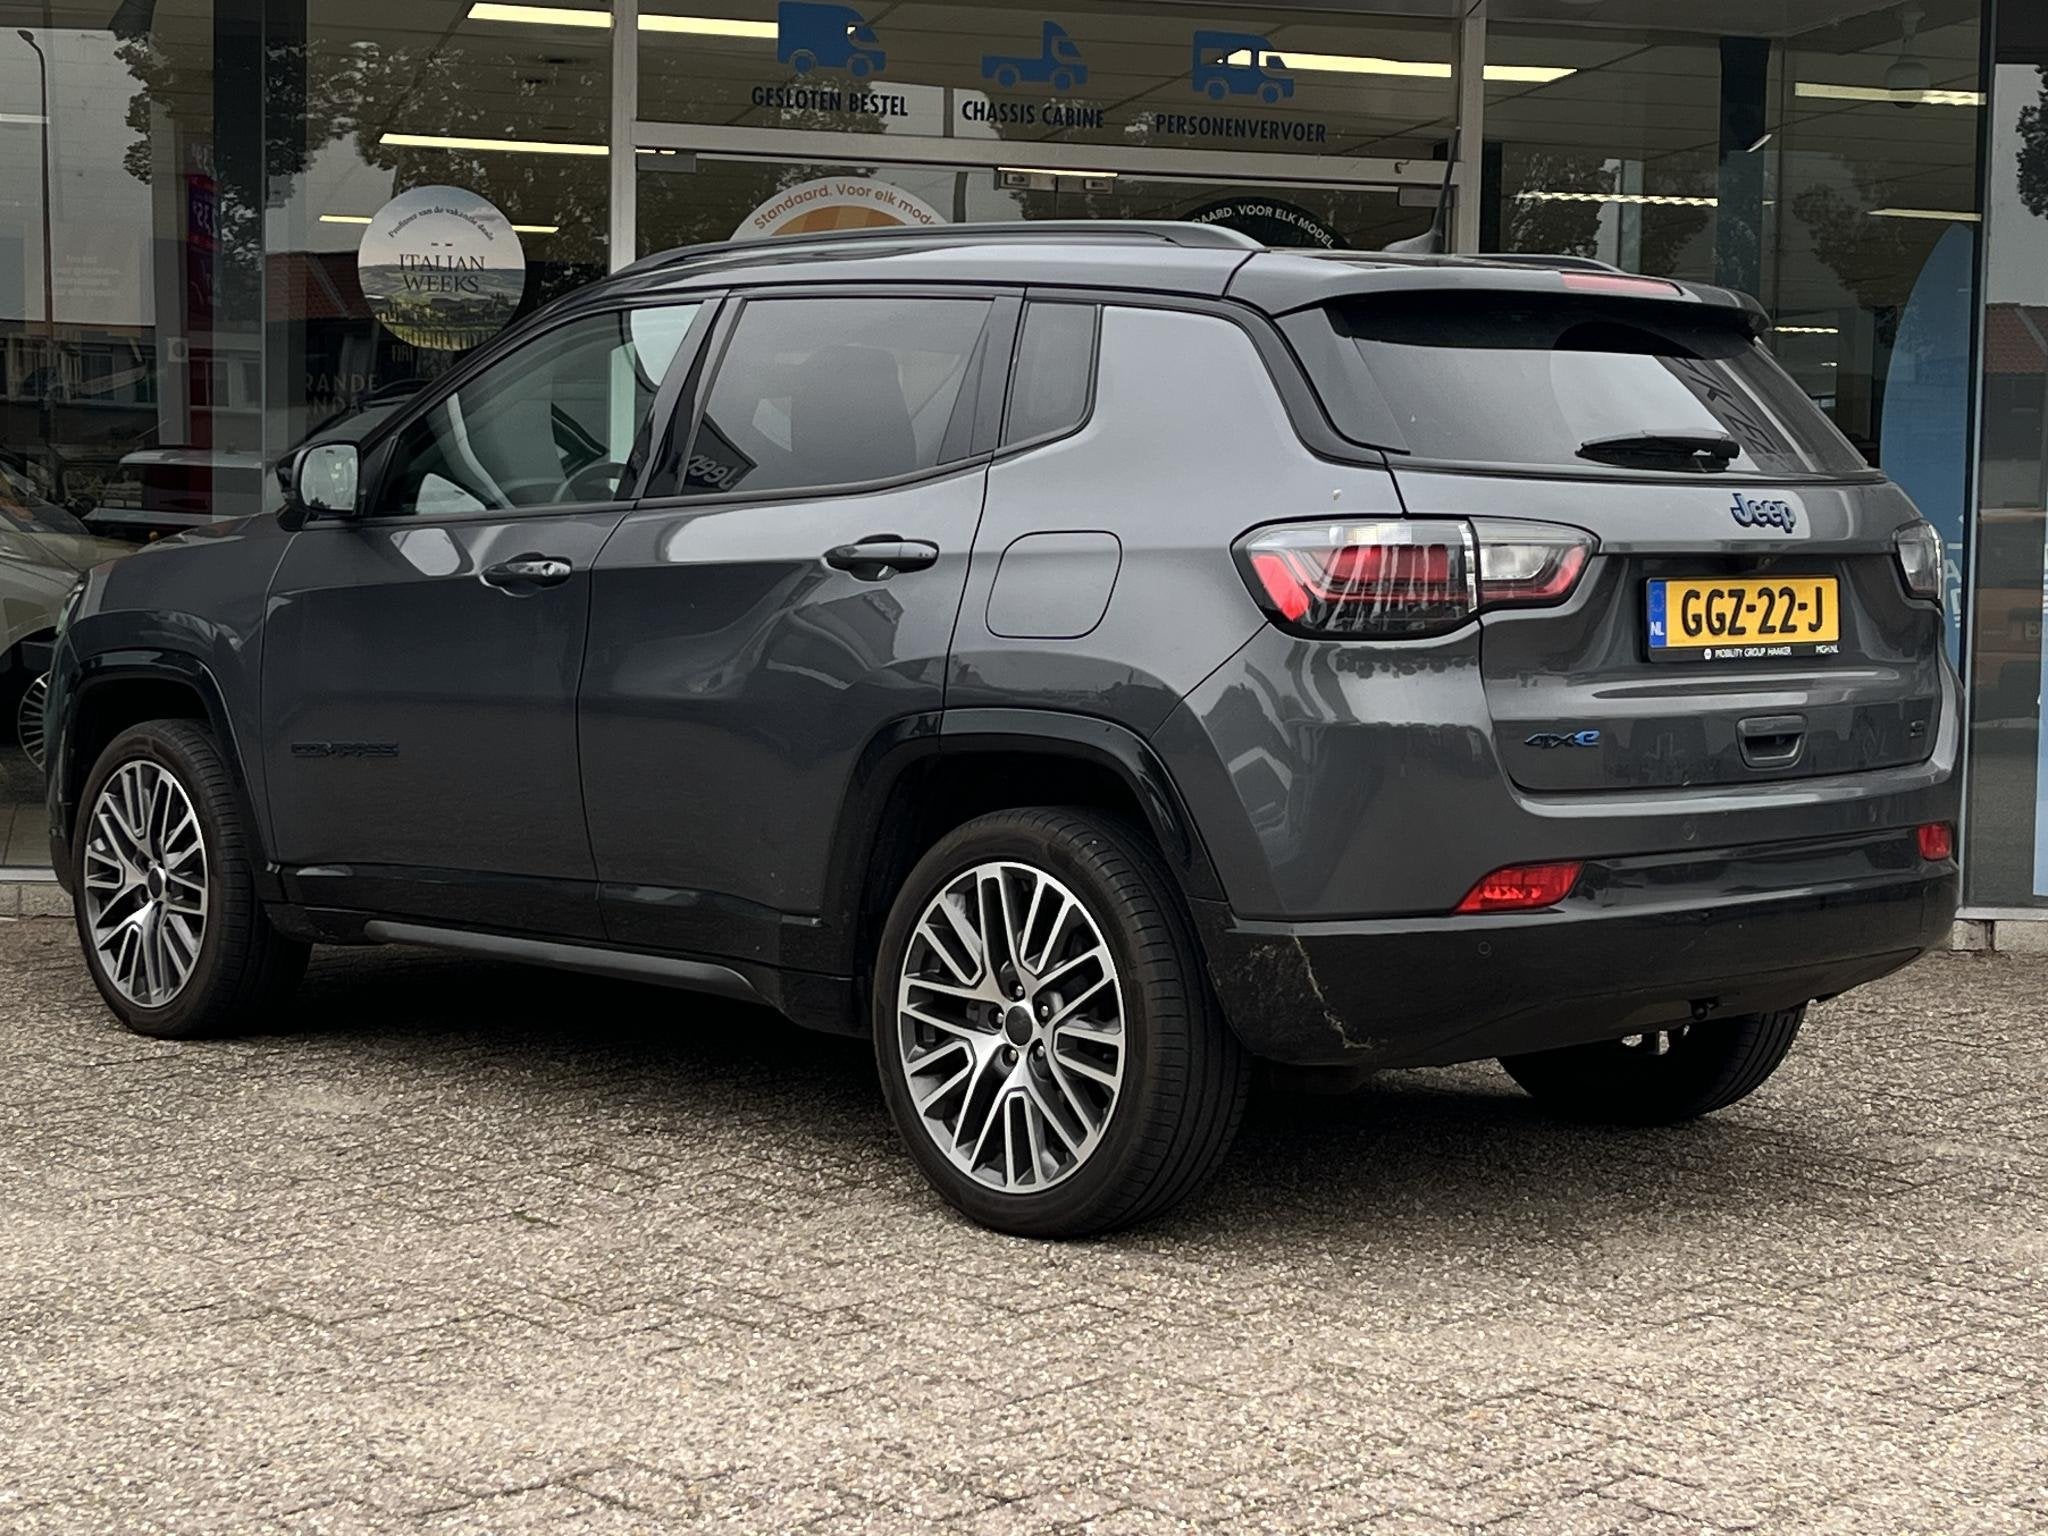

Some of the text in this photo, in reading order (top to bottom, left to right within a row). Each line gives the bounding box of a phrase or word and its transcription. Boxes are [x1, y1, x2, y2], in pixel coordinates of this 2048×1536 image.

[752, 86, 909, 117] GESLOTEN BESTEL
[962, 100, 1105, 128] CHASSIS CABINE
[1156, 113, 1327, 143] PERSONENVERVOER
[418, 208, 433, 217] van
[433, 206, 444, 214] de
[754, 185, 833, 230] Standaard.
[836, 184, 872, 197] Voor
[874, 188, 897, 206] elk
[1238, 205, 1272, 217] VOOR
[1275, 208, 1298, 224] ELK
[1297, 217, 1335, 249] MODEL
[399, 253, 486, 272] ITALIAN
[403, 274, 480, 294] WEEKS
[305, 373, 379, 395] RANDE
[1730, 492, 1797, 534] Jeep
[1681, 585, 1823, 637] GGZ-22-J
[1650, 621, 1665, 636] NL
[1715, 648, 1743, 658] MOBILITY
[1744, 647, 1766, 657] GROUP
